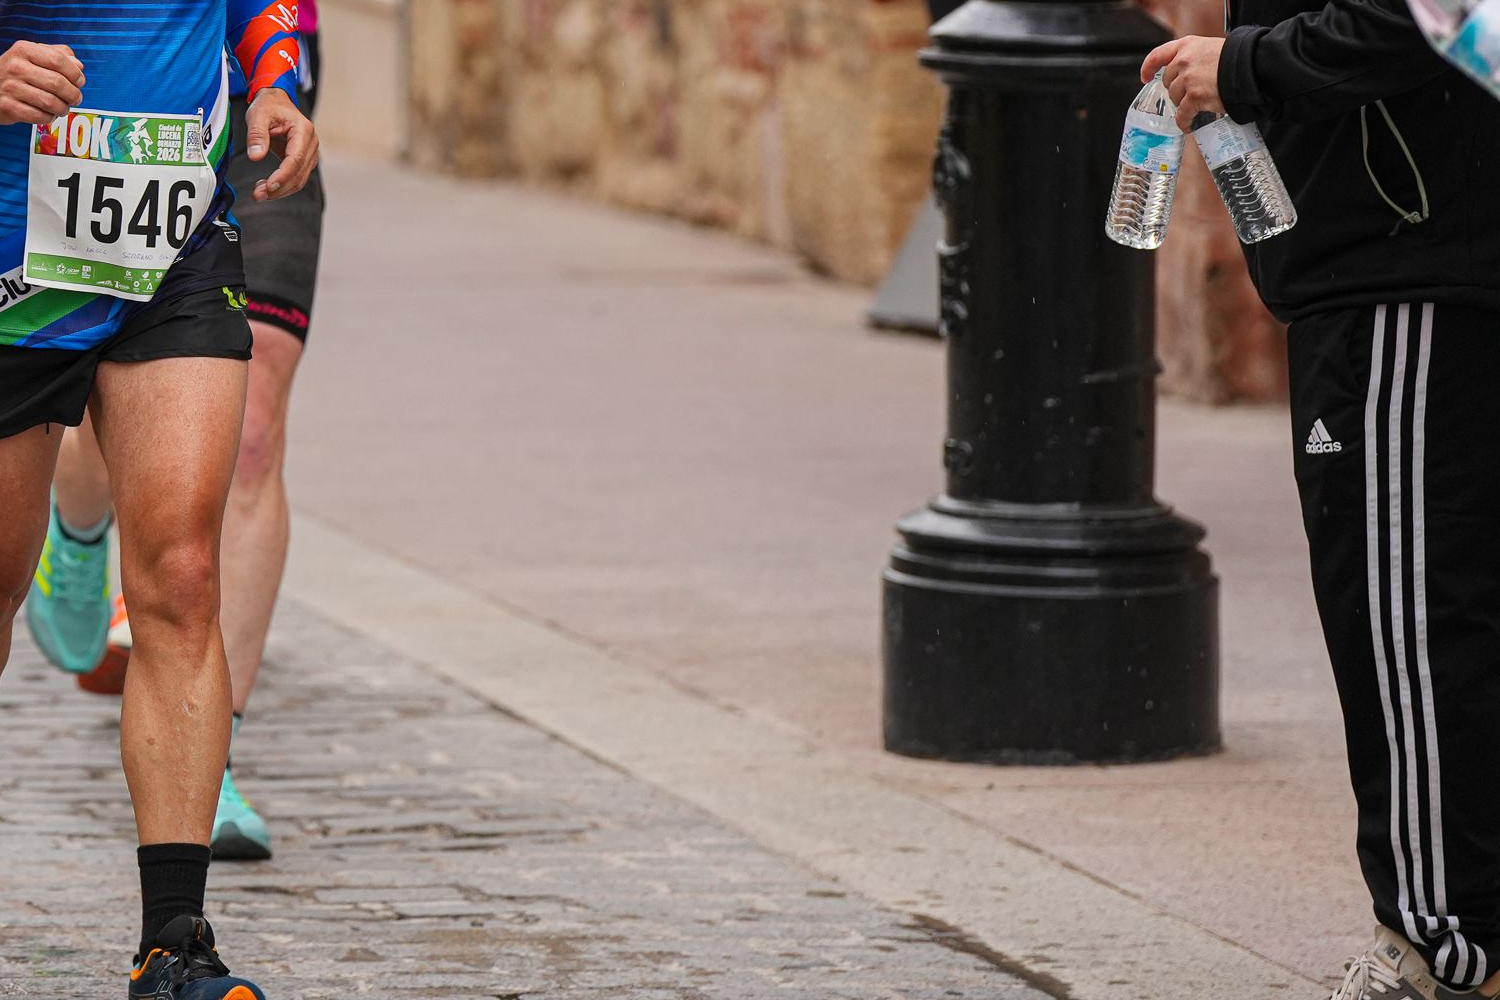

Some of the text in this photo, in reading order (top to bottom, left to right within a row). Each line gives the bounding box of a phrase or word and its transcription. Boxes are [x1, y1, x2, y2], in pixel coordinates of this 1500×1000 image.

[51, 115, 114, 160] 10K
[156, 148, 180, 162] 2026
[57, 172, 196, 250] 1546
